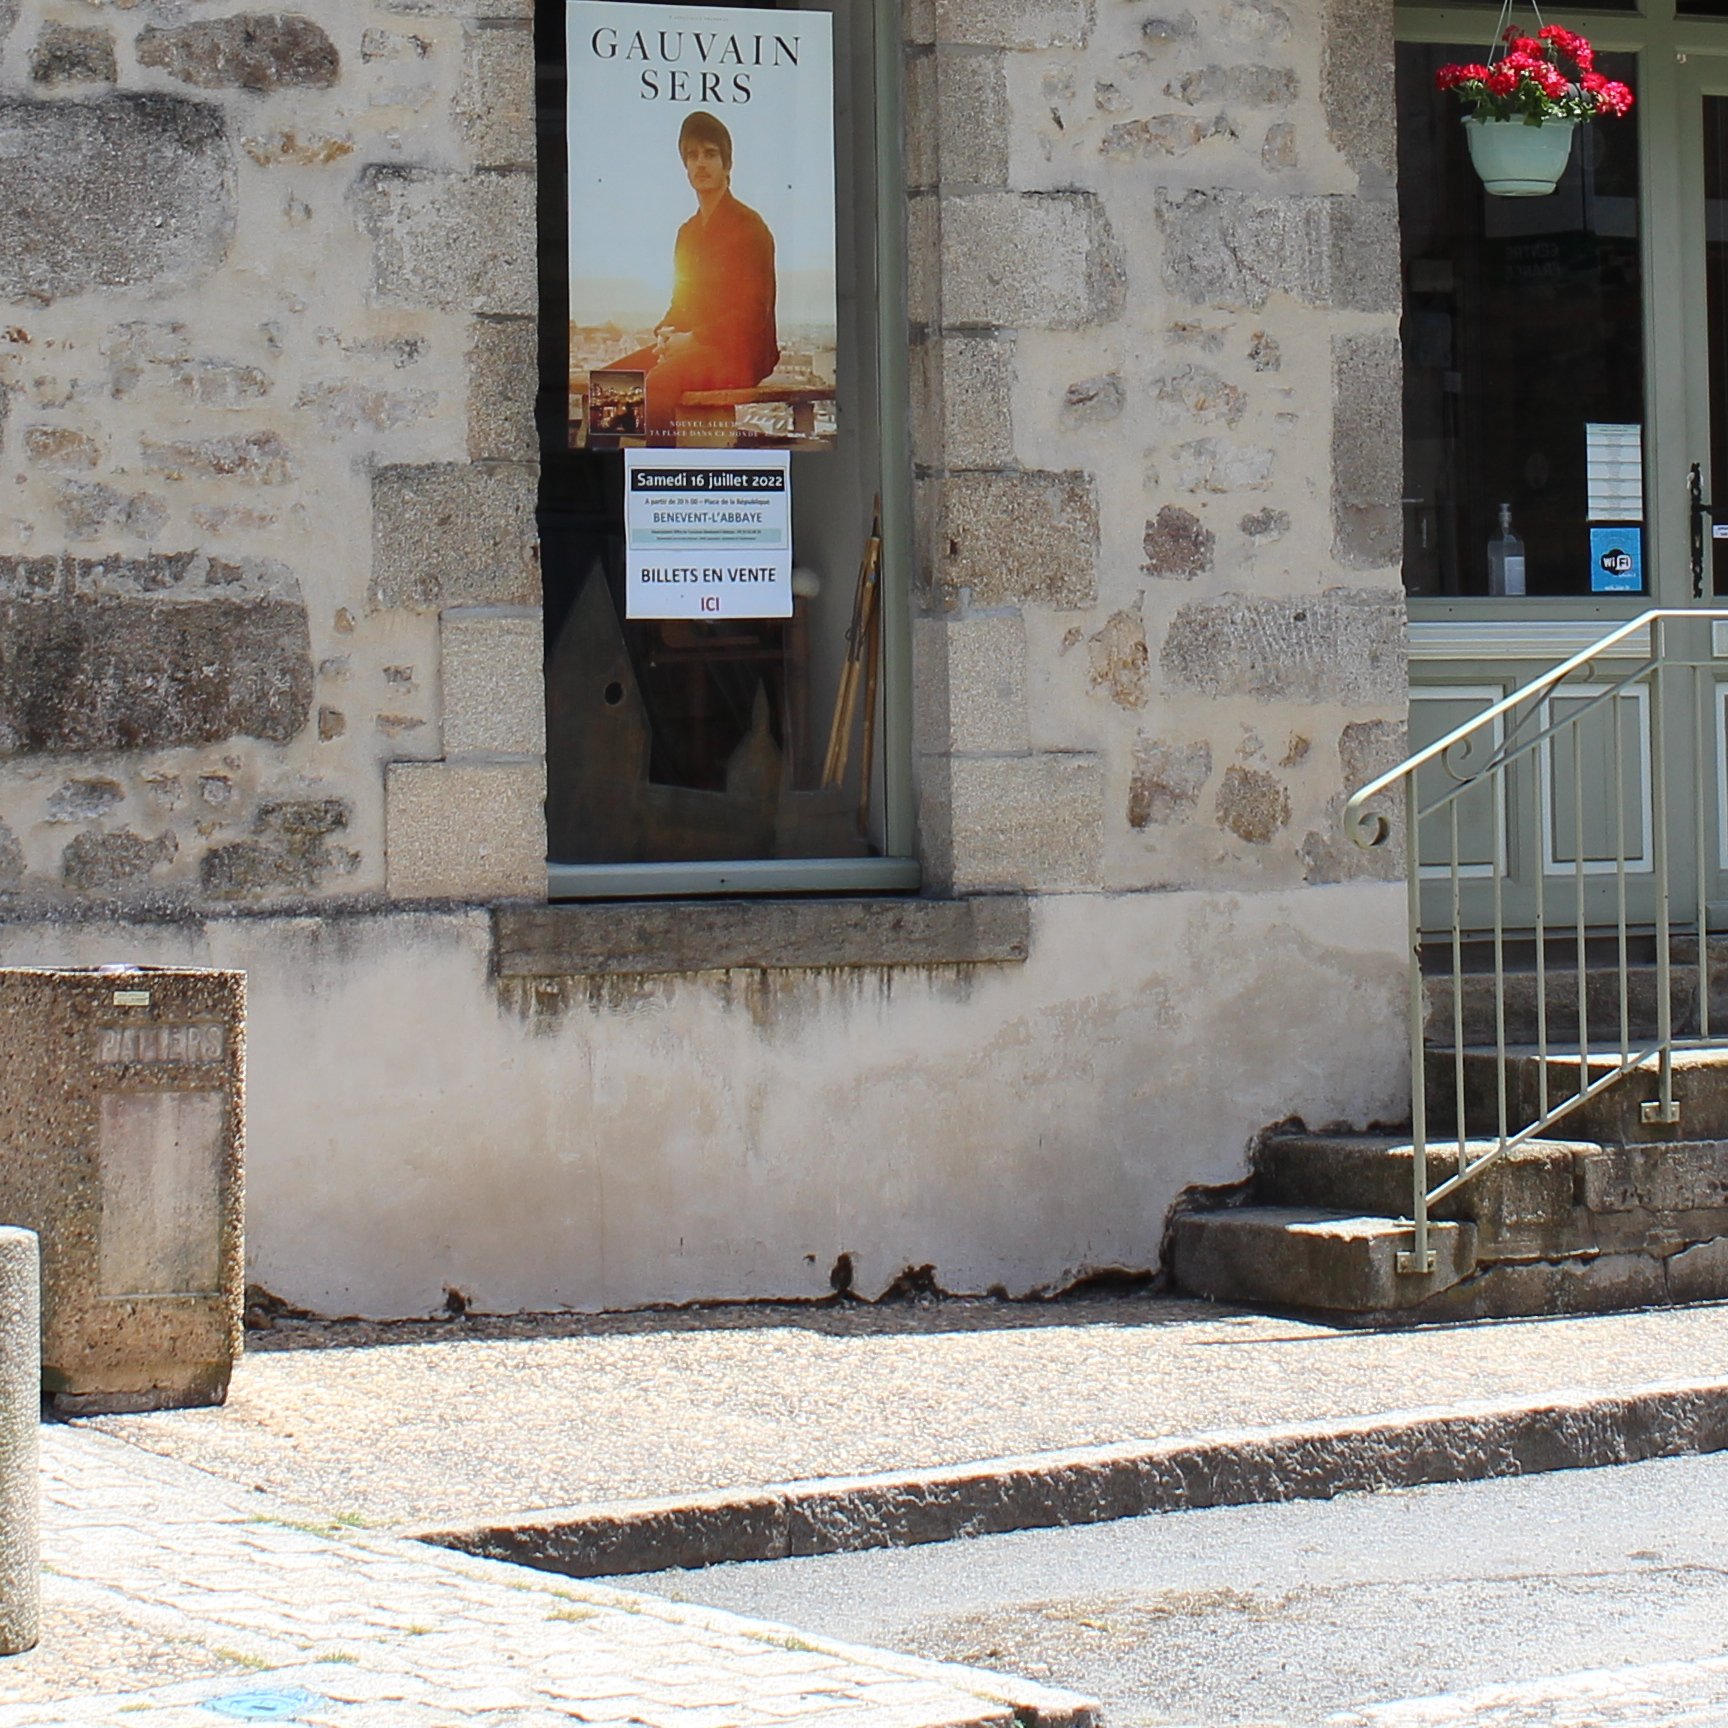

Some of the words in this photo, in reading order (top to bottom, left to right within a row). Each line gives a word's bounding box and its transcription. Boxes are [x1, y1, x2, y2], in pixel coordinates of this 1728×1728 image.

[591, 27, 801, 67] GAUVAIN
[640, 69, 752, 104] SERS
[637, 472, 687, 486] Samedi
[691, 473, 704, 486] 16
[709, 473, 748, 489] juillet
[752, 476, 783, 487] 2022
[641, 568, 698, 583] BILLETS
[703, 568, 723, 583] EN
[727, 567, 776, 583] VENTE
[700, 596, 720, 612] ICI
